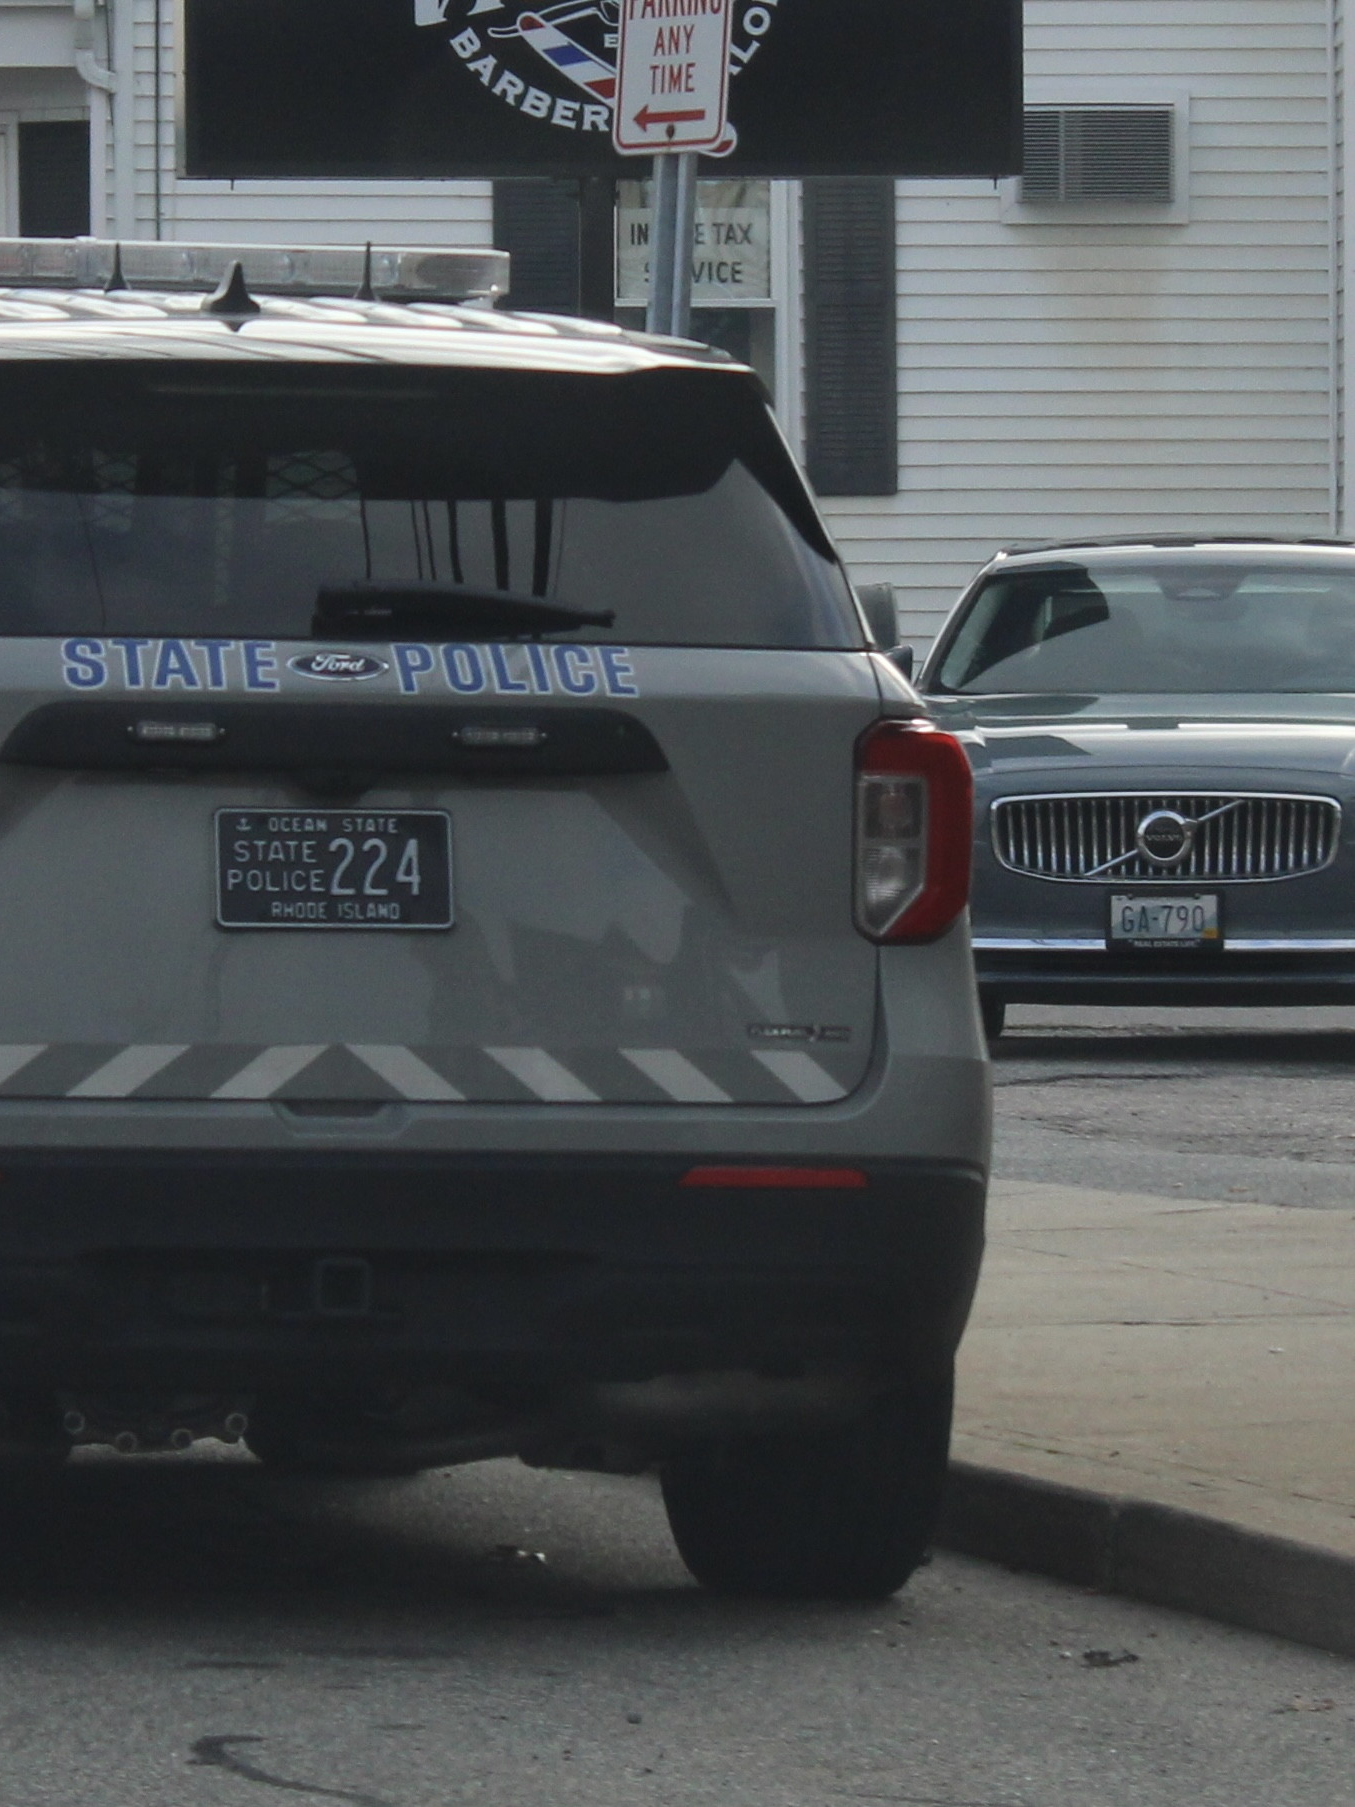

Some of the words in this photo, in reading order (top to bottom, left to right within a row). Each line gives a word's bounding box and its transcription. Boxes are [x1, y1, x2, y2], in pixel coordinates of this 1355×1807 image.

[653, 24, 695, 57] ANY
[449, 27, 611, 133] BARBER
[649, 62, 696, 95] TIME
[630, 222, 706, 245] INE
[712, 222, 753, 245] TAX
[60, 637, 282, 692] STATE
[390, 642, 640, 698] POLICE
[311, 653, 365, 671] Ford
[268, 817, 328, 833] OCEAN
[342, 818, 398, 834] STATE
[233, 840, 317, 863] STATE
[328, 837, 421, 896] 224
[226, 869, 326, 892] POLICE
[271, 902, 327, 918] RHODE
[336, 903, 401, 920] ISLAND
[1121, 905, 1205, 933] GA-790
